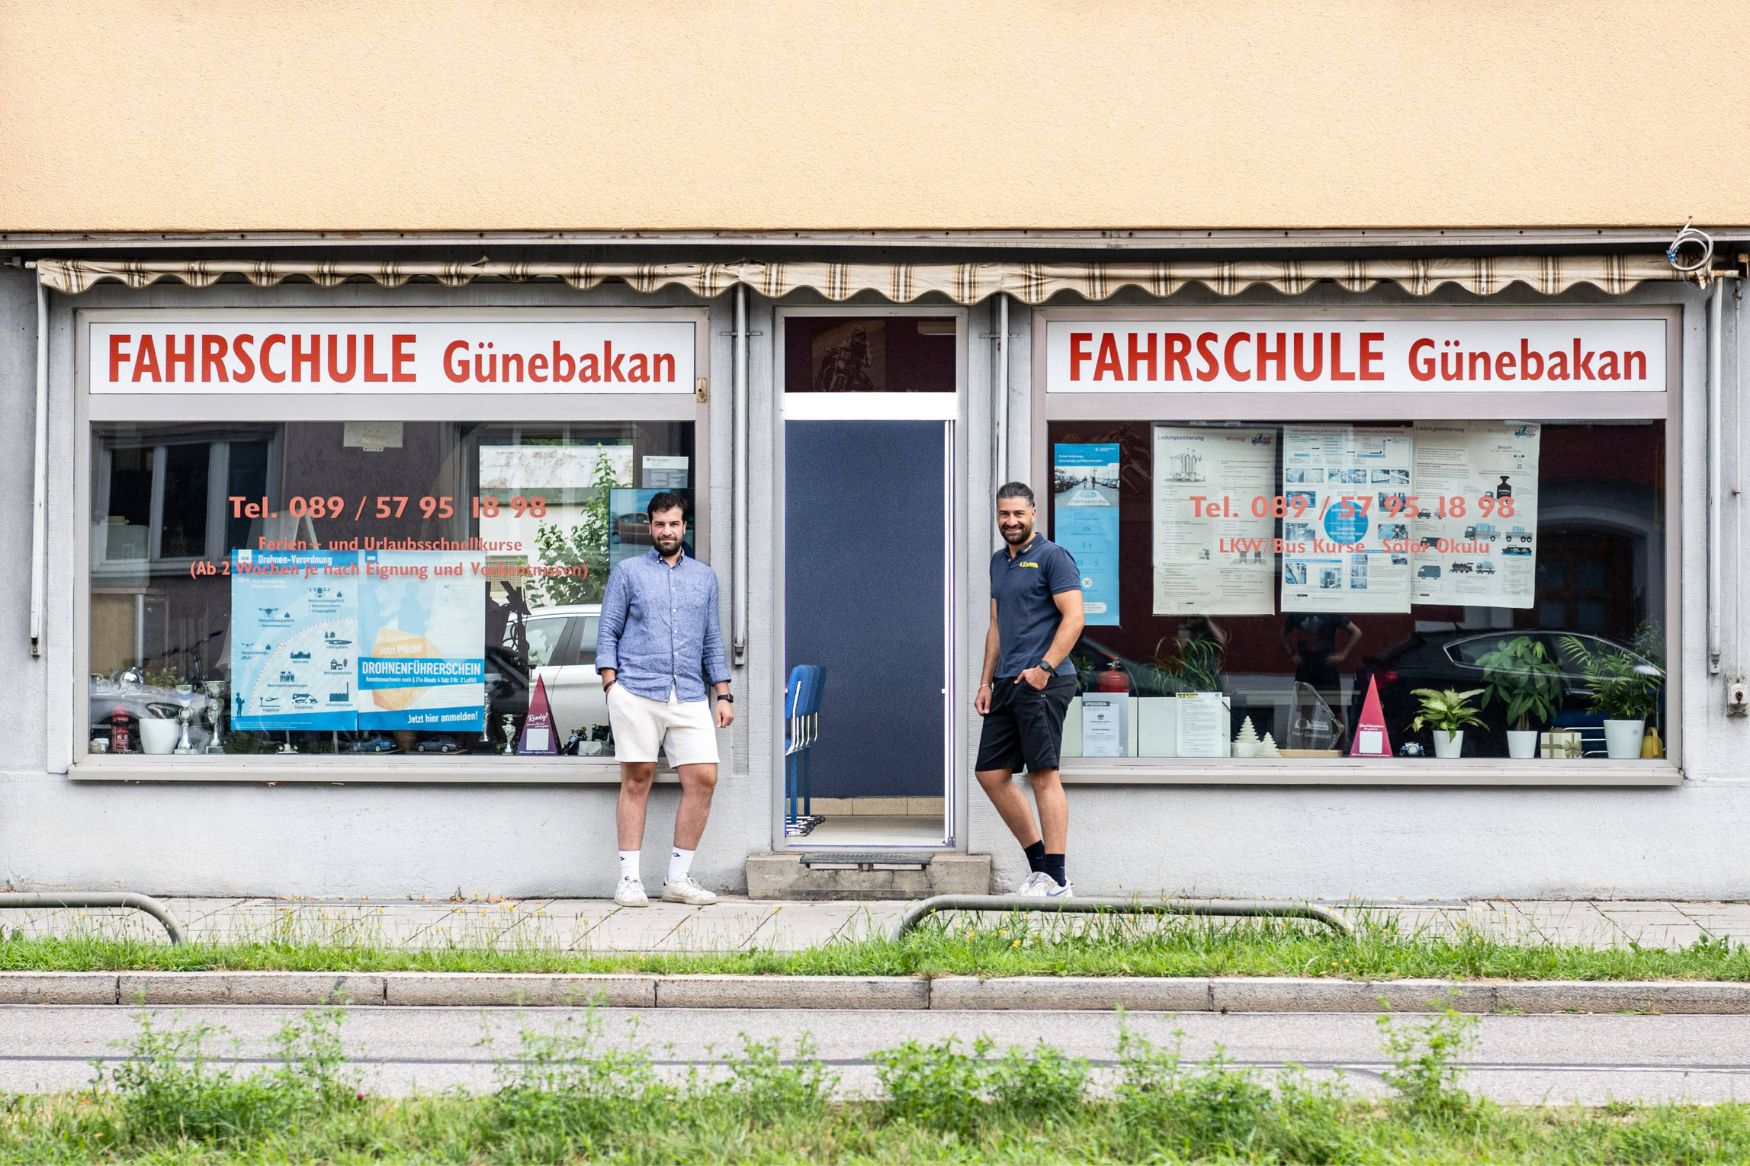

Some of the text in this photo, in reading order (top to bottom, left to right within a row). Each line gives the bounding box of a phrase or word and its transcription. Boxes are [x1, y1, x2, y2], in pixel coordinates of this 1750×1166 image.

[109, 334, 676, 384] FAHRSCHULE Günebakan
[1069, 332, 1647, 382] FAHRSCHULE Günebakan
[229, 495, 548, 521] Tel. 089 / 57 95 18 98
[1189, 496, 1516, 521] Tel. 089 / 57 95 18 98
[329, 537, 359, 551] und
[364, 537, 522, 552] Urlaubsschnellkurse
[1313, 539, 1365, 554] Kurse
[1436, 538, 1490, 554] Okulu
[190, 560, 217, 579] (Ab
[221, 561, 230, 576] 2
[235, 561, 299, 576] Wochen
[304, 561, 318, 579] je
[324, 561, 360, 576] nach
[366, 562, 428, 580] Eignung
[434, 562, 463, 577] und
[361, 660, 481, 675] DROHNENFÜHRERSCHEIN
[408, 711, 479, 724] Jetzt hier anmelden!
